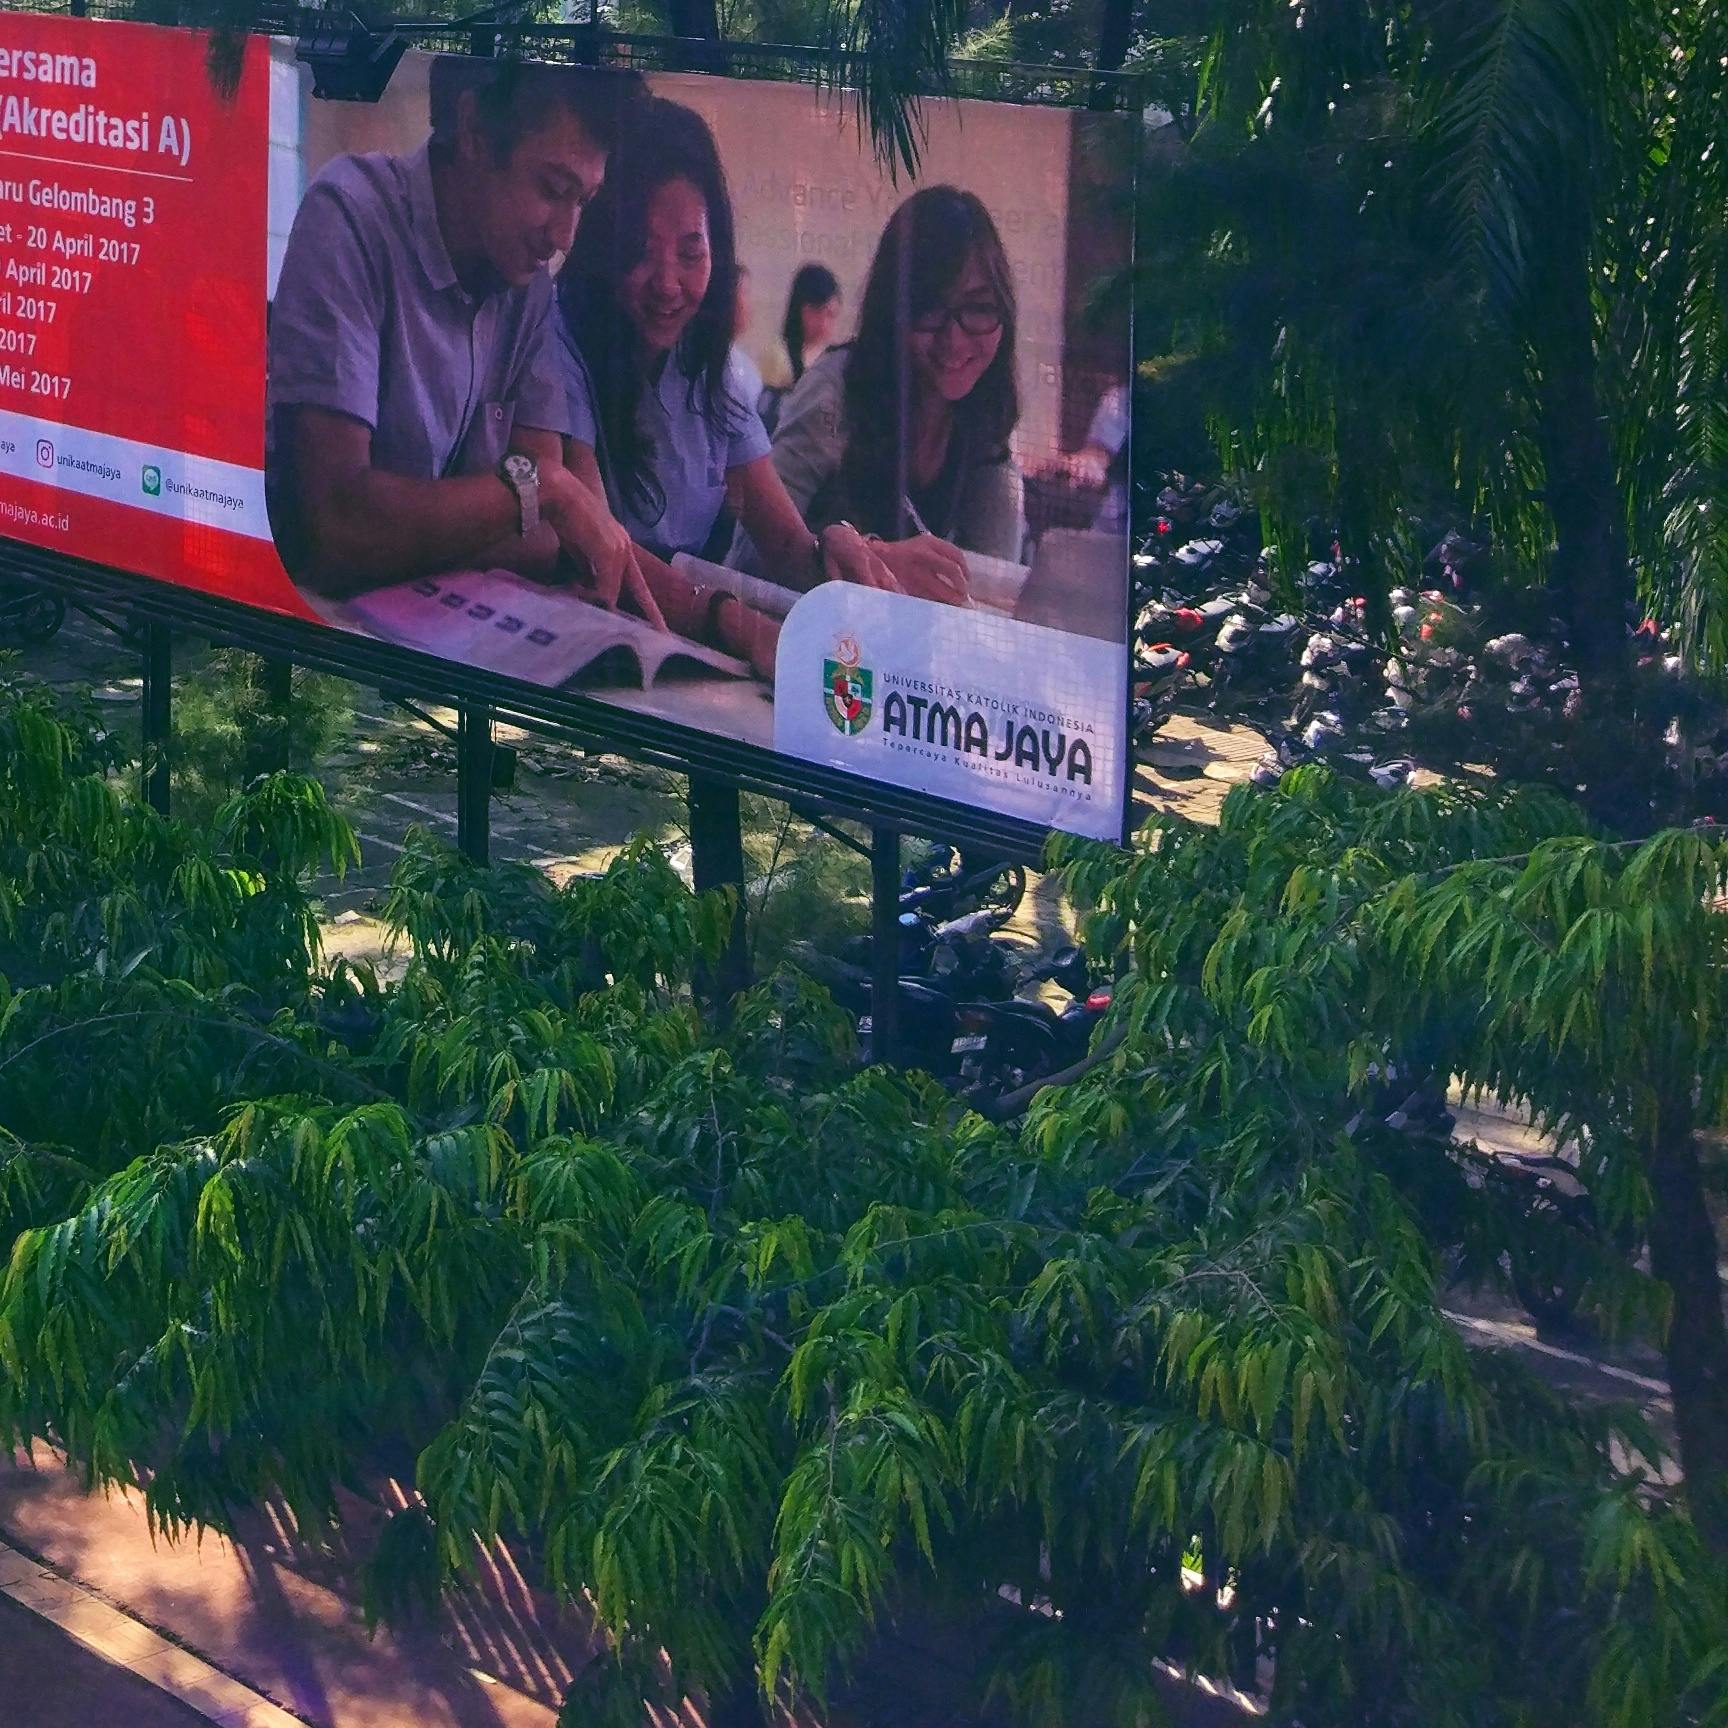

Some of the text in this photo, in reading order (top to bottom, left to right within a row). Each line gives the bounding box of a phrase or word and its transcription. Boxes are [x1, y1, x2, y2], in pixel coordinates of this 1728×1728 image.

[157, 115, 191, 166] A)
[29, 179, 137, 228] Gelombang
[142, 197, 155, 224] 3
[27, 225, 47, 249] 20
[52, 230, 93, 259] April
[98, 238, 140, 265] 2017
[5, 258, 46, 287] April
[51, 265, 92, 294] 2017
[16, 295, 57, 323] 2017
[30, 371, 71, 399] 2017
[57, 454, 121, 480] unikaatmajaya
[165, 478, 244, 511] @unikaatmajaya
[883, 672, 1094, 735] UNIVERSITAS KATOLIK INDONESIA
[883, 690, 1093, 786] ATMA JAYA
[954, 757, 1009, 780] Kualitas
[1016, 772, 1092, 802] Lulusannya
